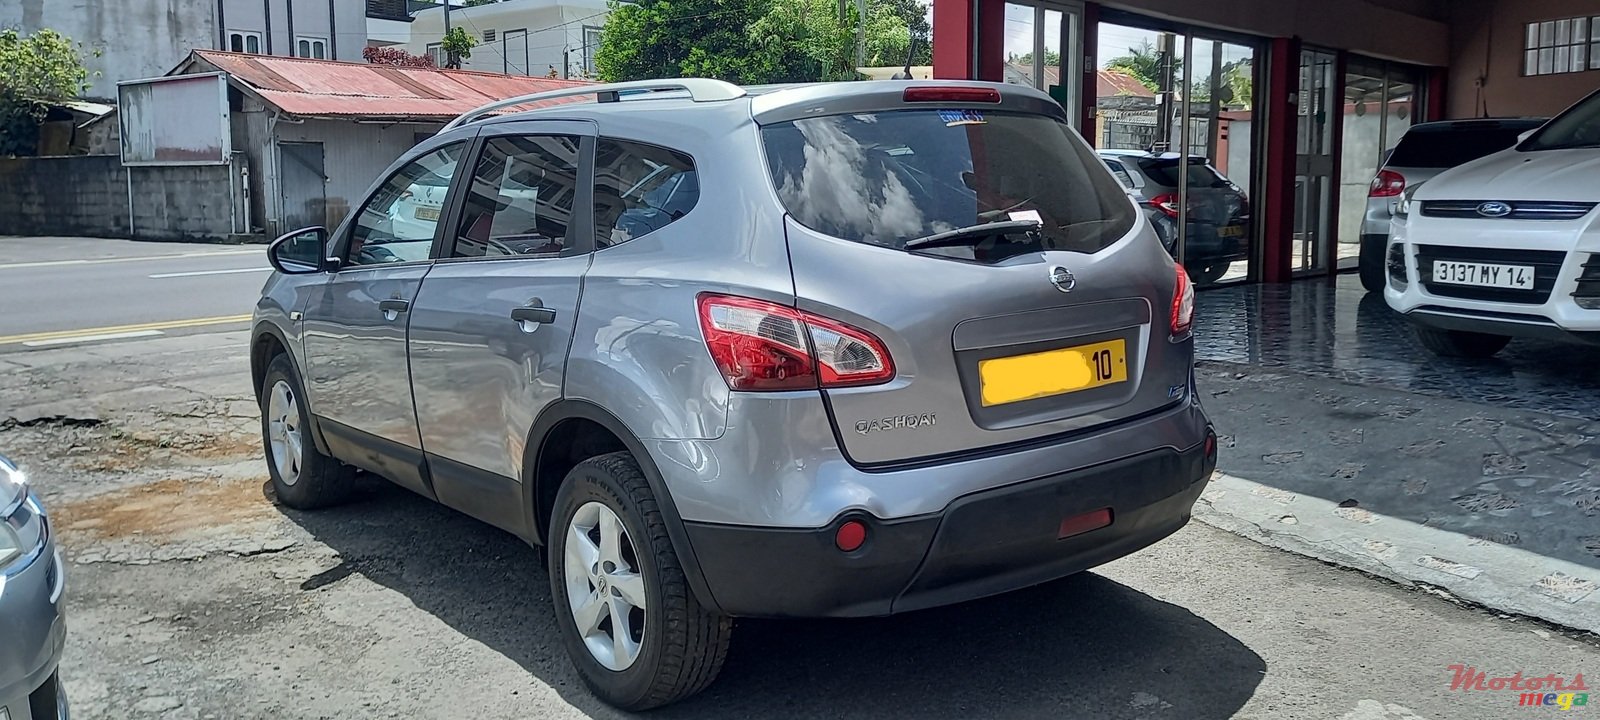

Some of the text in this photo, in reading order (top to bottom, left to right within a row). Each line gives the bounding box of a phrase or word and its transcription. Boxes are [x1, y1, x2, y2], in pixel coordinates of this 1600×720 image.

[1440, 263, 1525, 286] 3137 MY 14
[1092, 349, 1112, 381] 10
